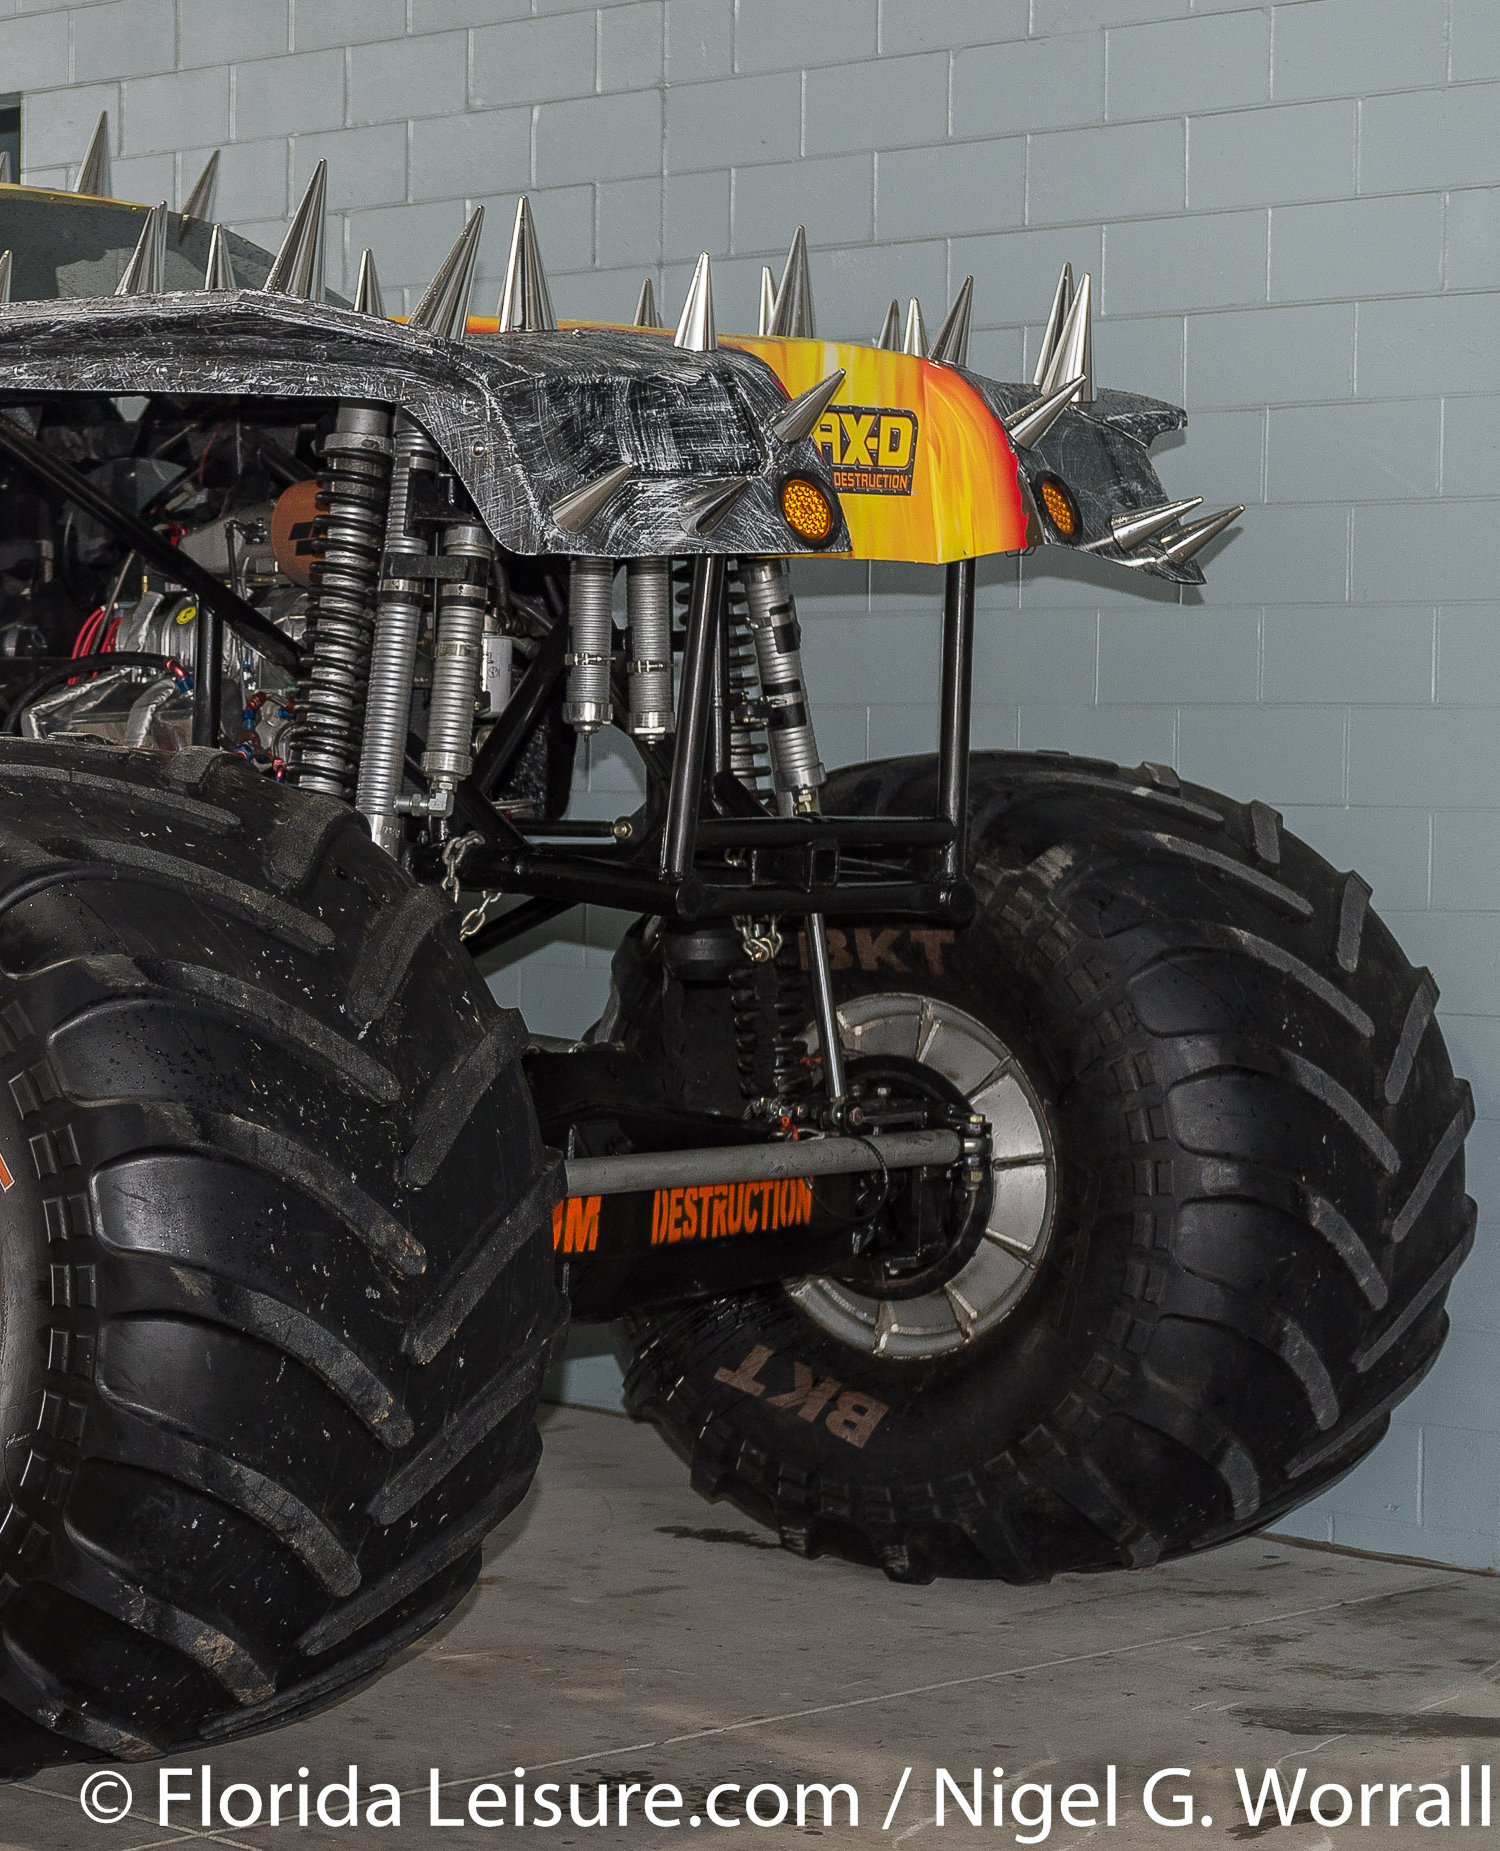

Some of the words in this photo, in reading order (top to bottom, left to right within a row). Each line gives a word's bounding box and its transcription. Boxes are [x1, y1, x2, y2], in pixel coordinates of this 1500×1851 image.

[812, 411, 914, 467] AX-D
[833, 471, 909, 489] DESTRUCTION
[797, 927, 956, 976] BKT
[650, 1176, 815, 1246] DESTRUCTION
[714, 1344, 891, 1449] BKT
